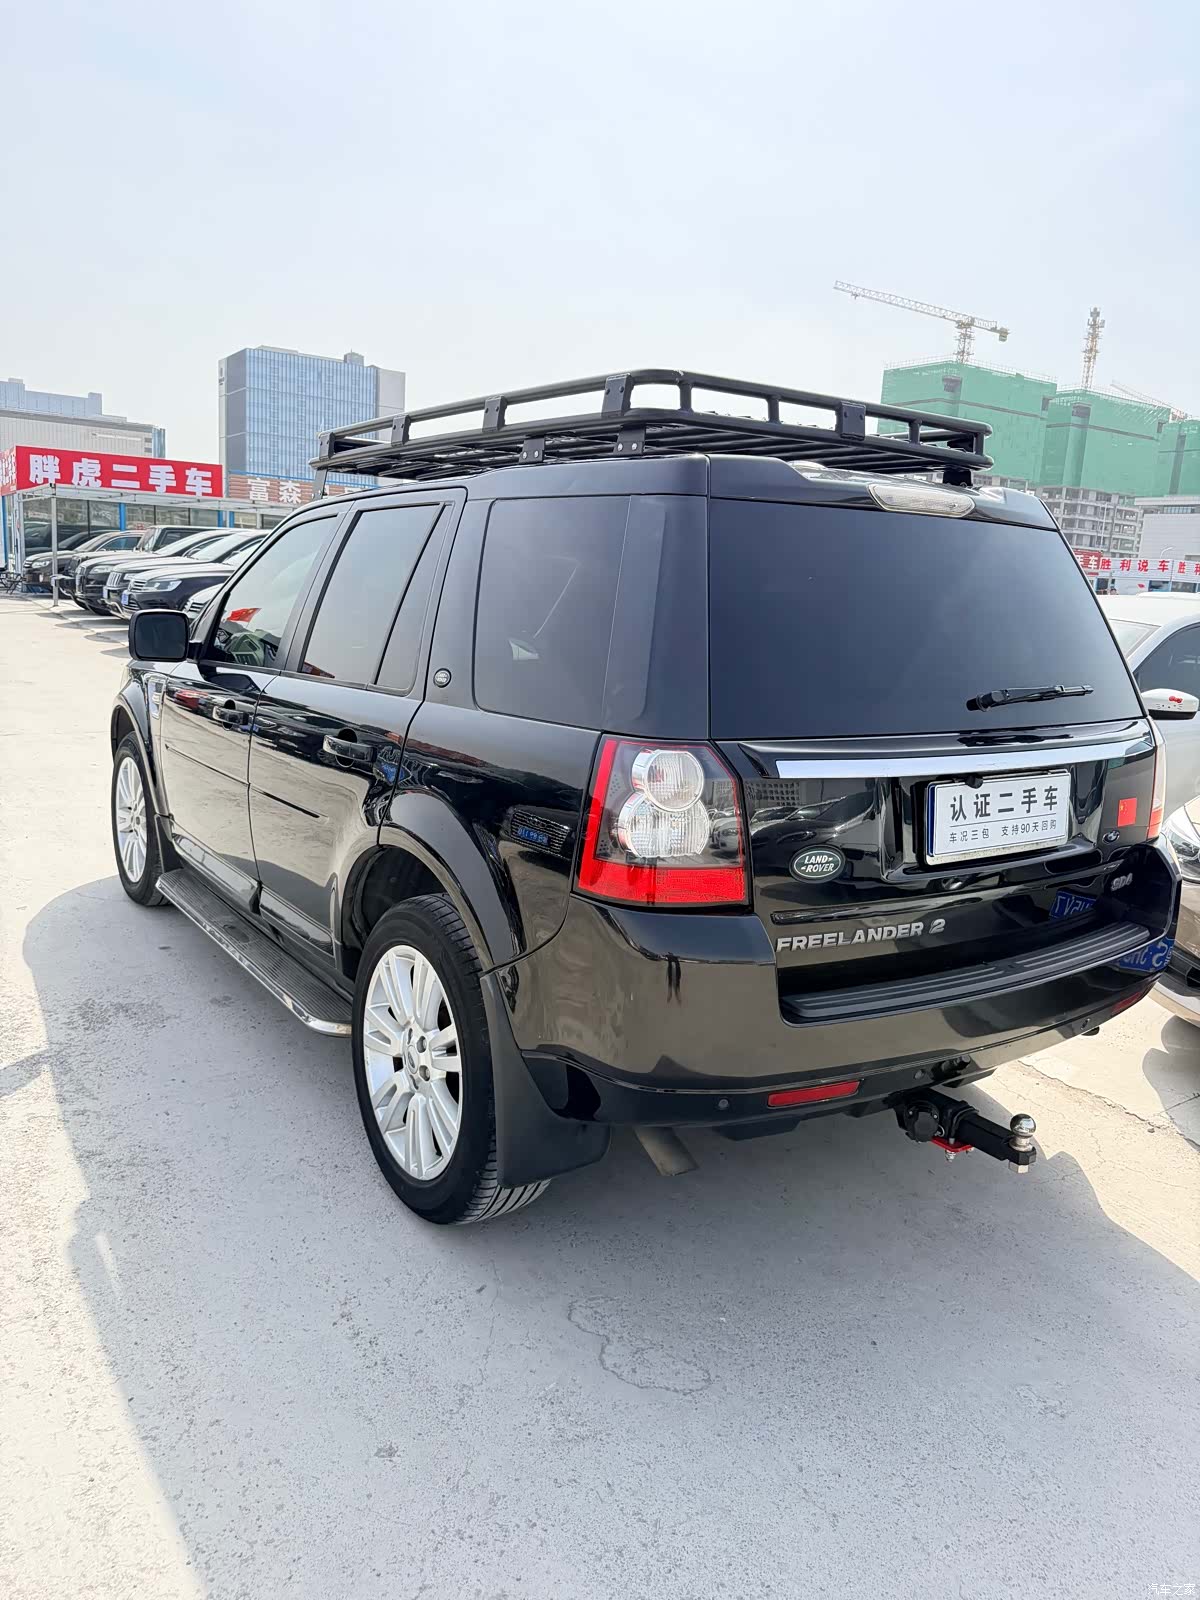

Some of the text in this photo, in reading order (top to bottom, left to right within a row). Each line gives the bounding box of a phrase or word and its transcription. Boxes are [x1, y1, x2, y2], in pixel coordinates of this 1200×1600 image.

[29, 454, 213, 498] 胖虎二手车
[949, 785, 1058, 822] 认证二手车
[949, 819, 1057, 844] 车况三包 支持90天回购
[804, 855, 828, 864] LAND
[805, 863, 835, 873] ROVER
[776, 918, 946, 952] FREELANDER 2
